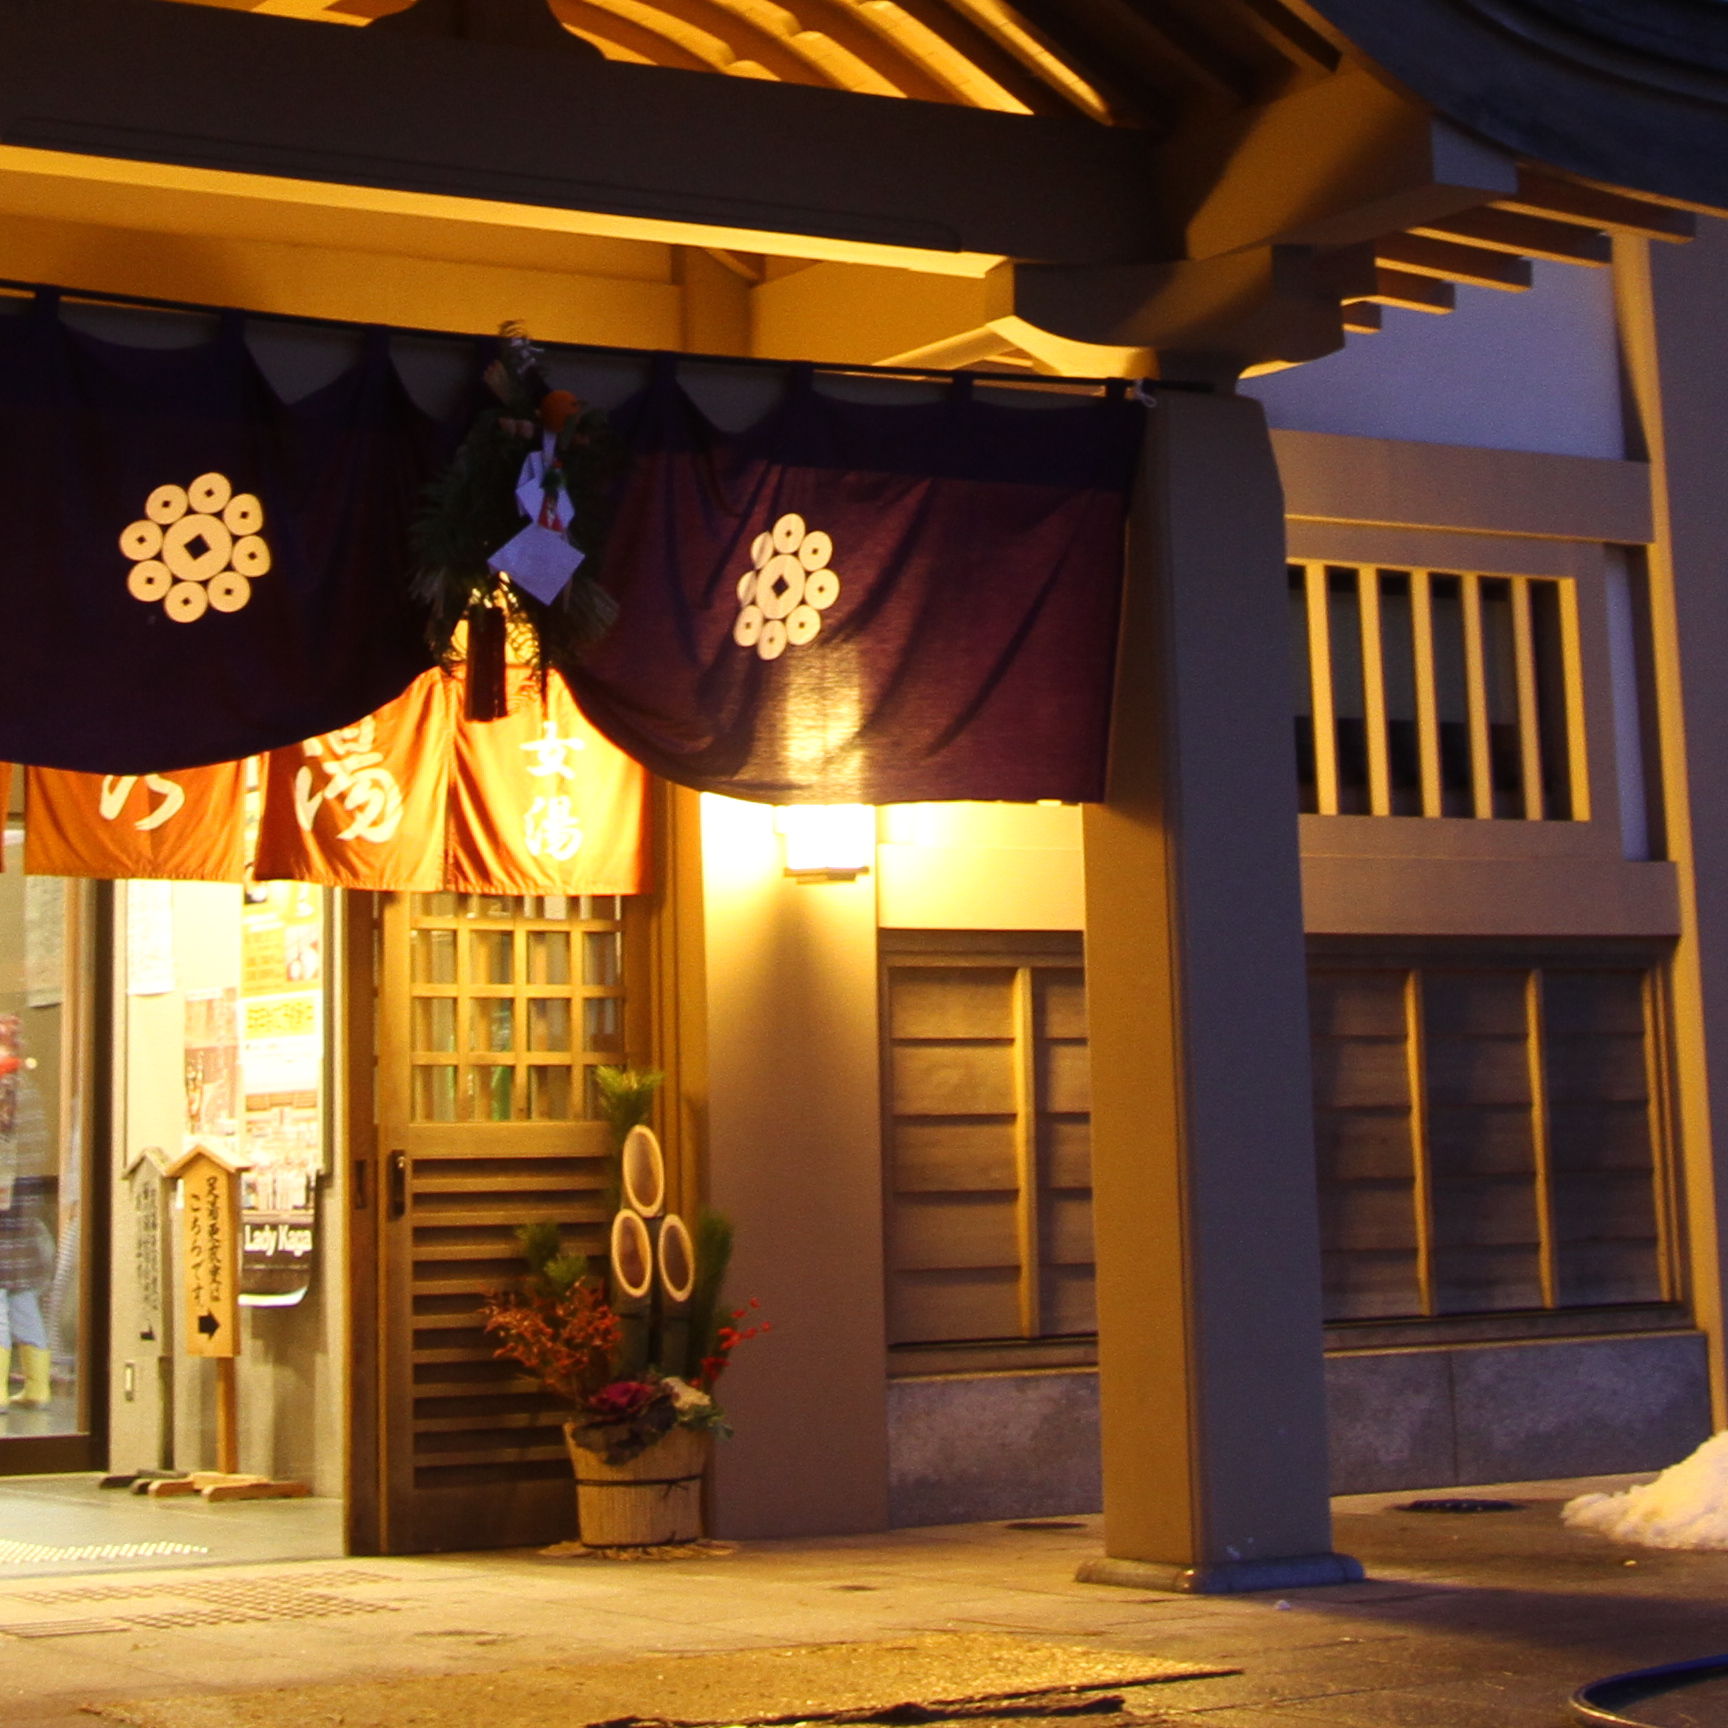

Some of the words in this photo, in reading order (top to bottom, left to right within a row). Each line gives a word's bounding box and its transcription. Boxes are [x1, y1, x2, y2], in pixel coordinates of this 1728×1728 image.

[519, 720, 585, 861] 女湯
[244, 1224, 277, 1257] Lady
[278, 1224, 313, 1257] Kaga
